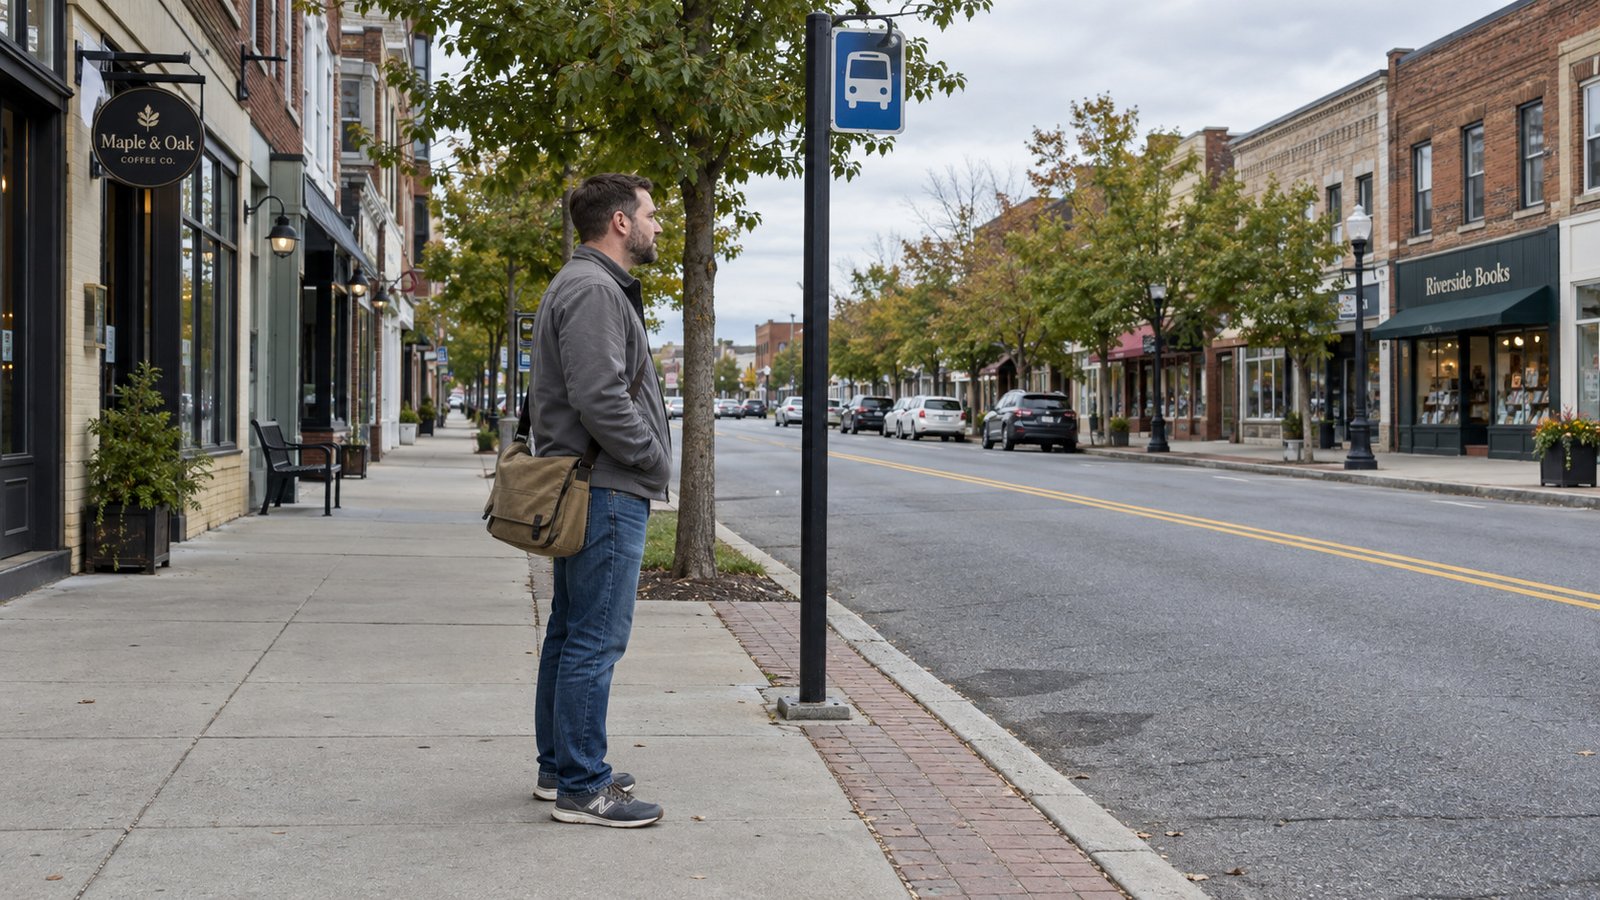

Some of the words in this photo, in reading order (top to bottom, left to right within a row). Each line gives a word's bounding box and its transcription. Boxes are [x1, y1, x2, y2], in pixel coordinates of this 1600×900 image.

[101, 134, 146, 152] Maple
[149, 136, 160, 149] &
[164, 135, 195, 150] Oak
[120, 156, 156, 164] COFFEE
[159, 157, 176, 165] CO.
[1426, 269, 1472, 296] Riverside
[1475, 262, 1511, 287] Books
[588, 796, 615, 814] N
